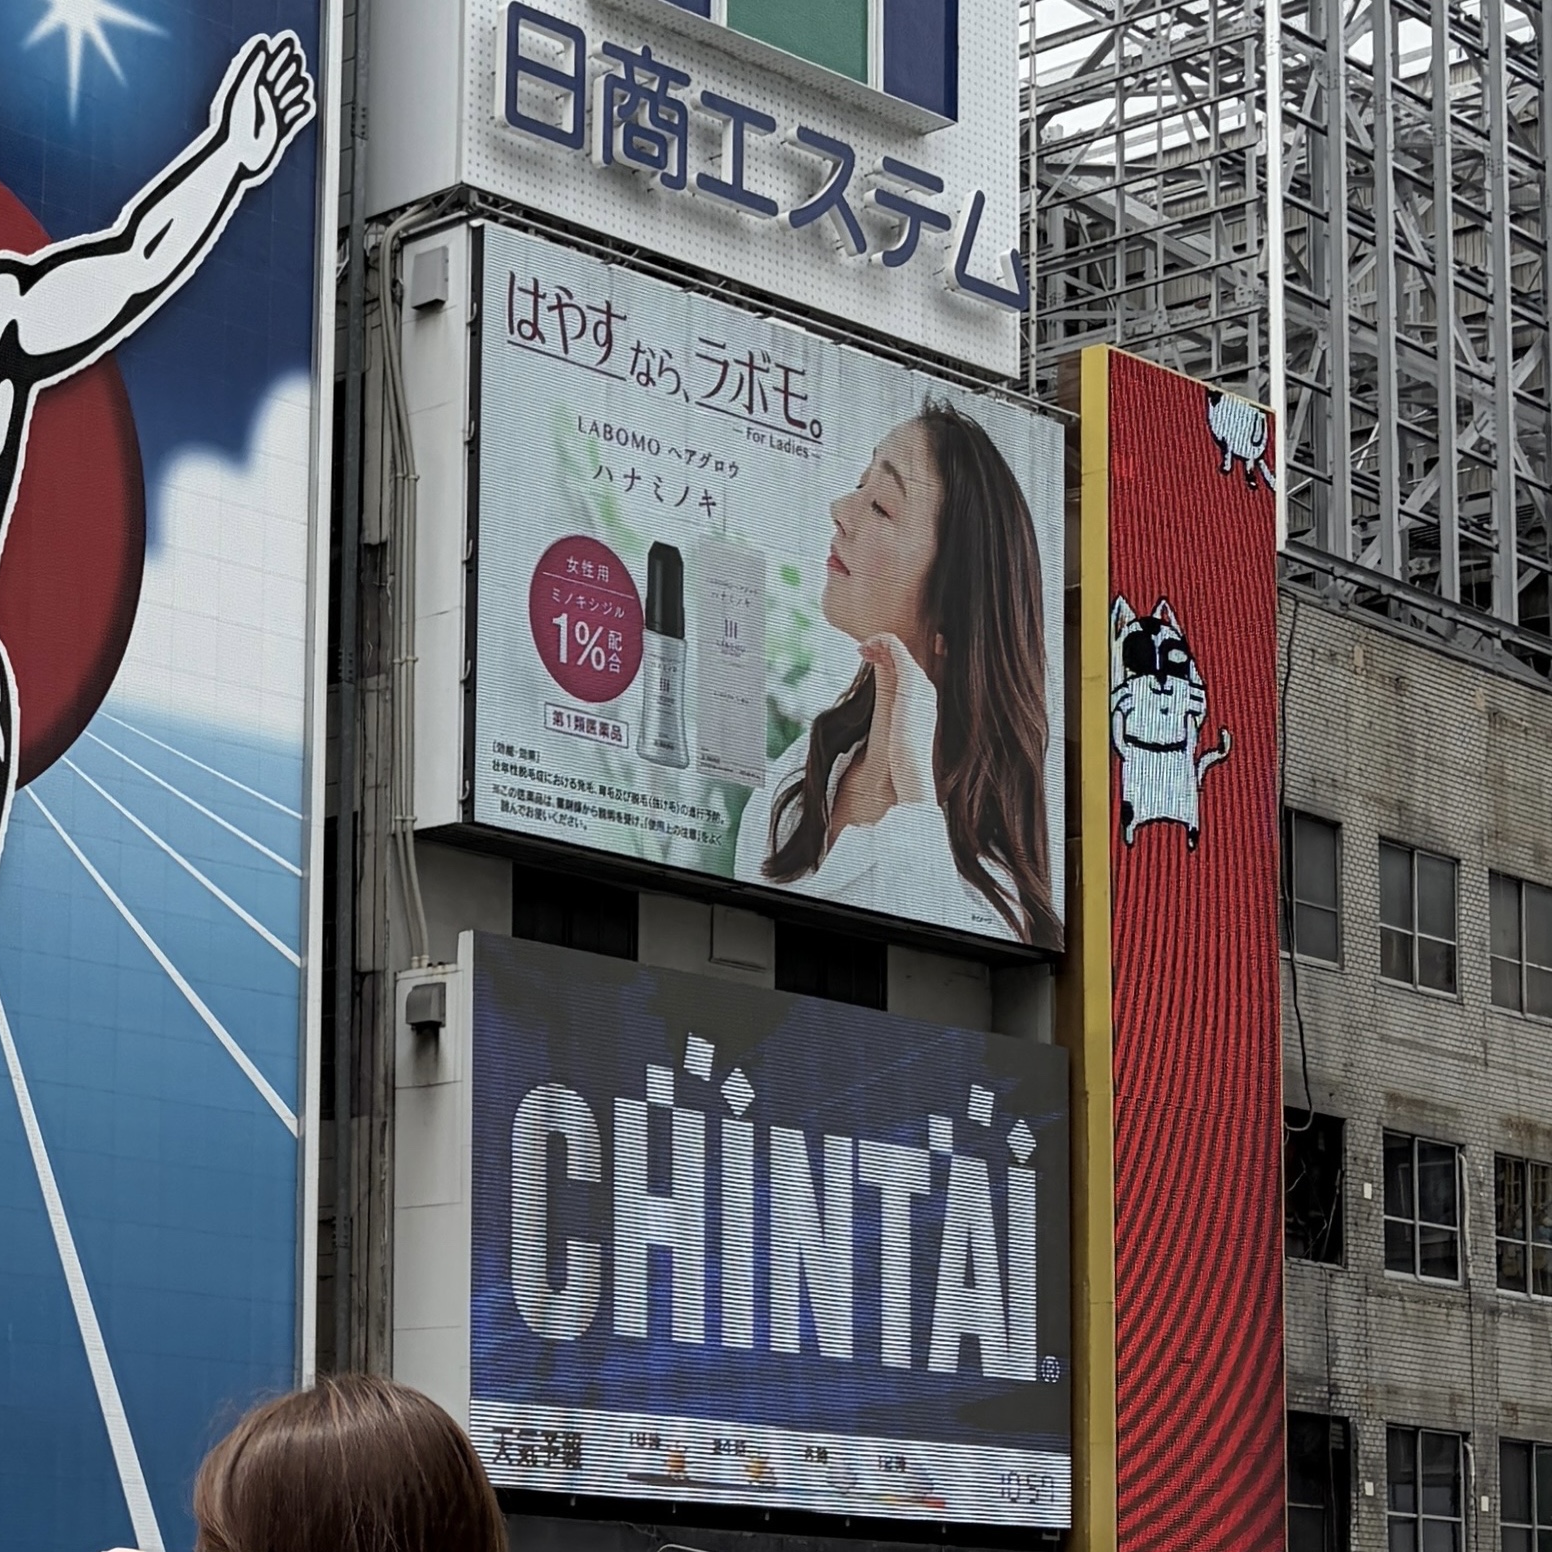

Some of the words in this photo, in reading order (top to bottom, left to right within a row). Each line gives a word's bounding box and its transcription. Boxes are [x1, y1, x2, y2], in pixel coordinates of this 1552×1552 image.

[504, 0, 1028, 310] 日商エステム
[578, 415, 661, 457] LABOMO
[668, 446, 740, 479] ヘアグロウ
[593, 465, 717, 518] ハナミノキ
[566, 555, 610, 583] 女性用
[551, 587, 625, 618] ミノキシジル
[552, 613, 606, 671] 1%
[552, 710, 623, 742] 第1類医薬品
[511, 1062, 1037, 1382] CHINTAI
